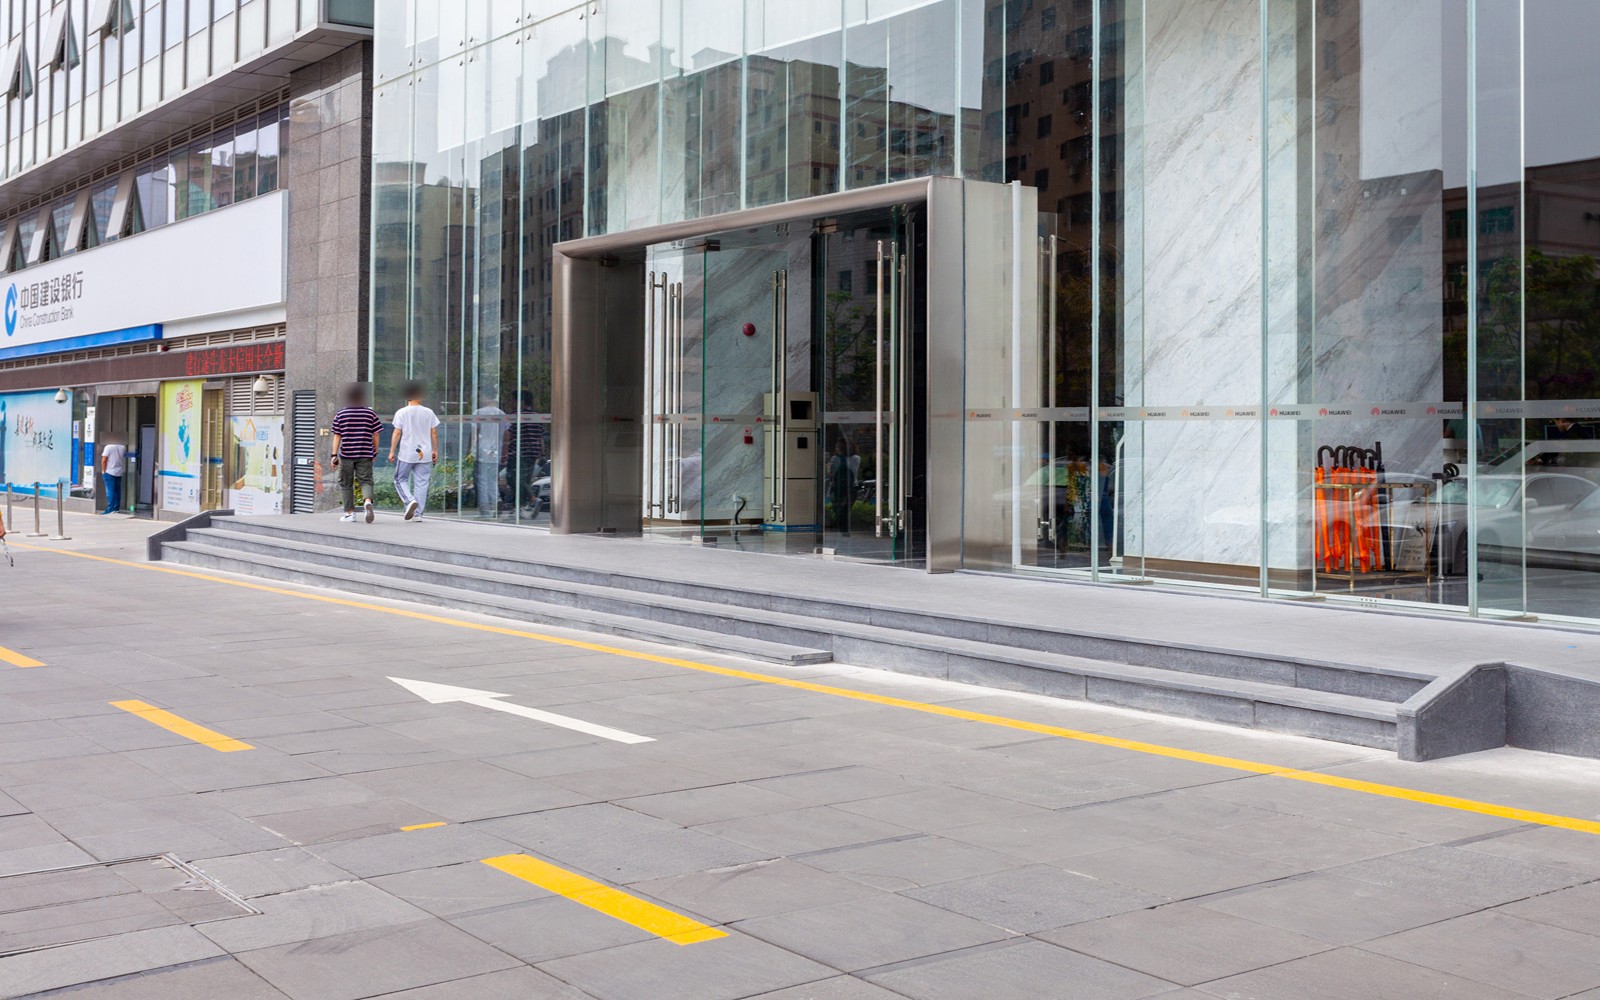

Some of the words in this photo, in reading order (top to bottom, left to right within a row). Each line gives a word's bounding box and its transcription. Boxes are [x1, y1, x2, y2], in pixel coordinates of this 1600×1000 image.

[20, 271, 83, 311] 中国建设银行
[20, 314, 32, 328] China
[33, 309, 60, 327] Construction
[61, 304, 74, 321] Bank
